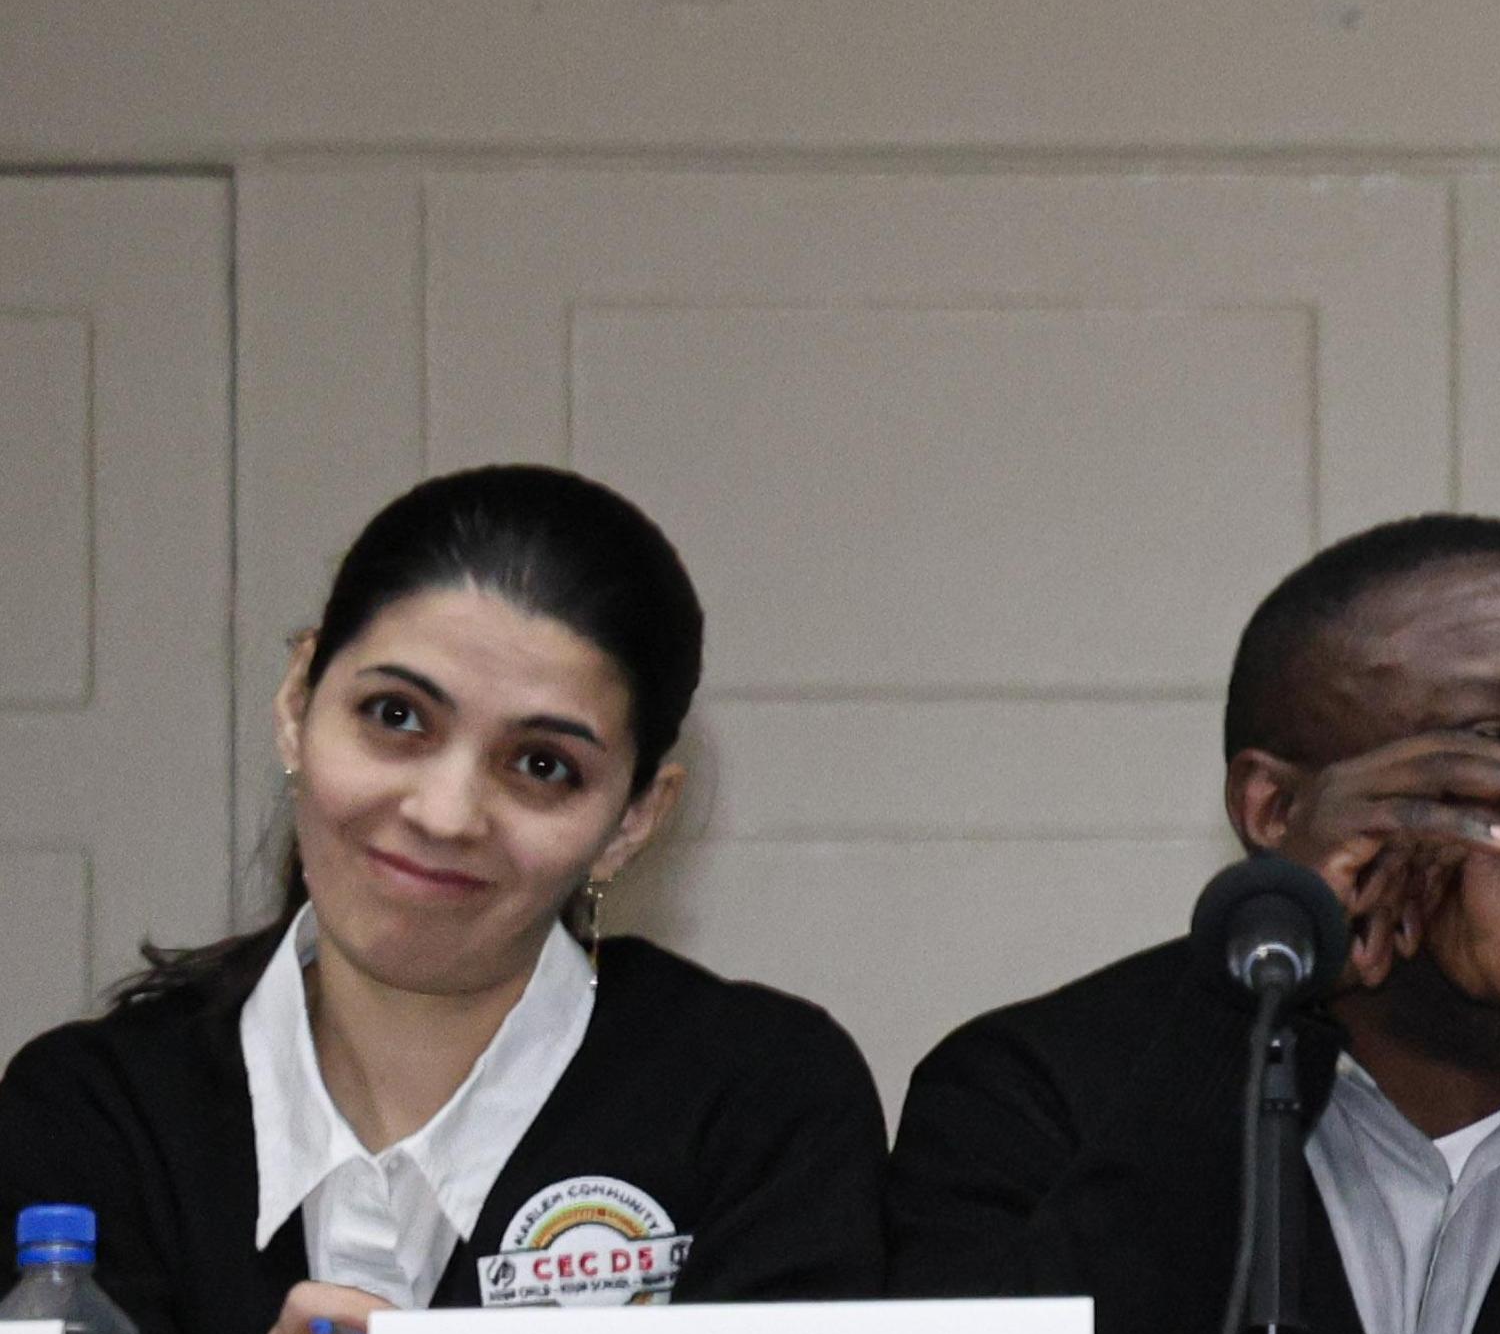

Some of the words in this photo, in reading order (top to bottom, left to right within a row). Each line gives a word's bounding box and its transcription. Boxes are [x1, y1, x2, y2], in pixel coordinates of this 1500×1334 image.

[567, 1182, 661, 1230] COMMUNITY
[532, 1251, 599, 1281] CEC
[610, 1246, 655, 1274] D5
